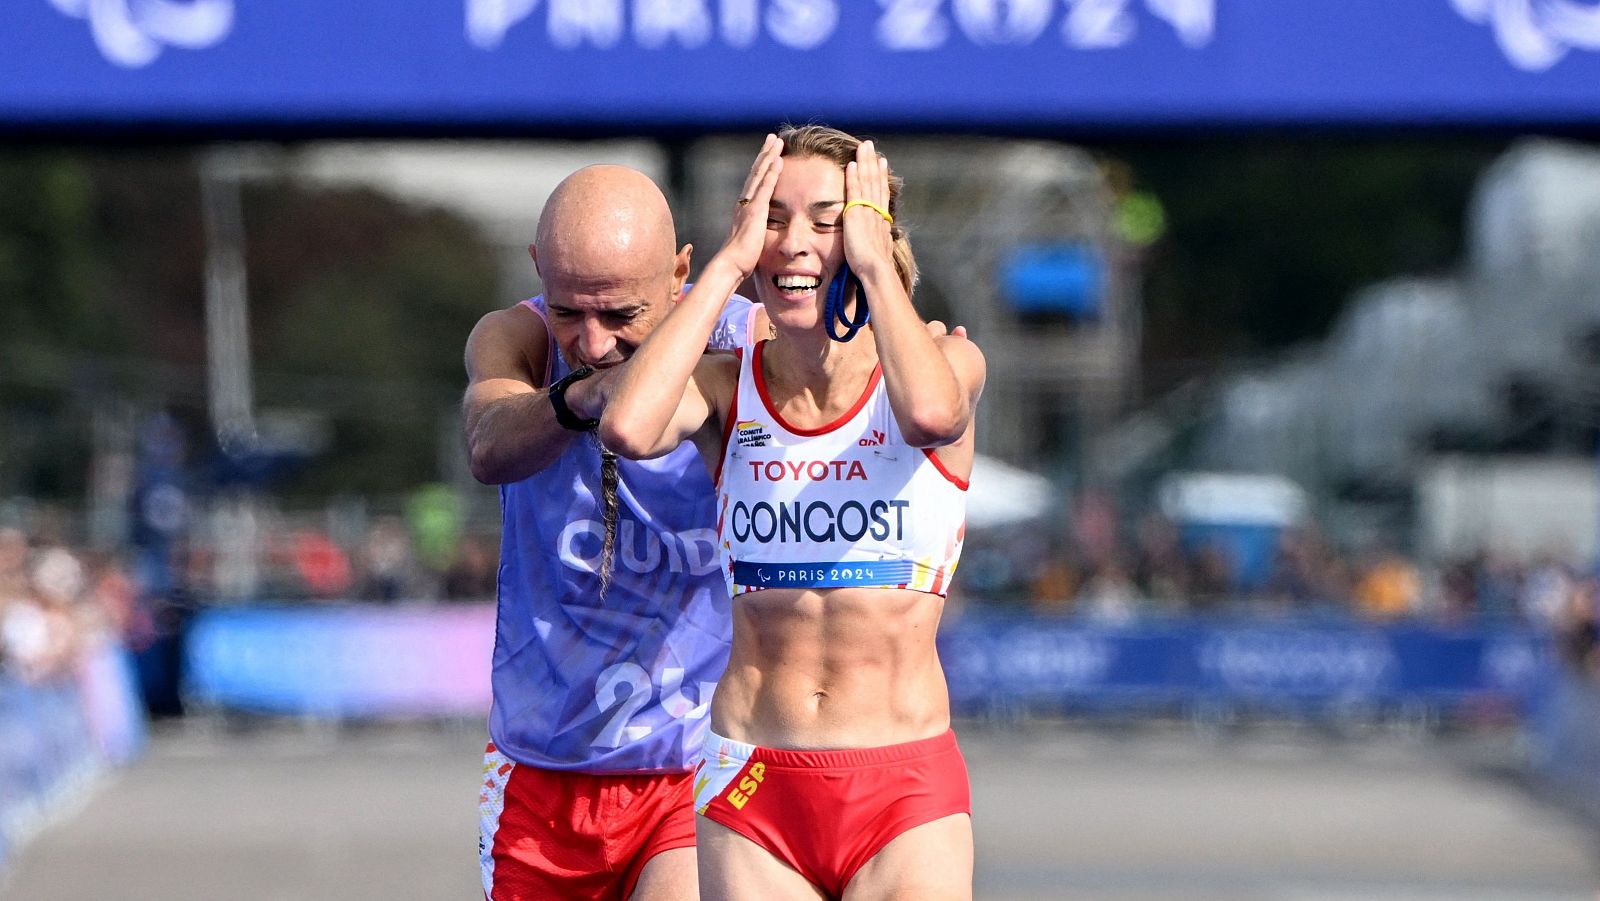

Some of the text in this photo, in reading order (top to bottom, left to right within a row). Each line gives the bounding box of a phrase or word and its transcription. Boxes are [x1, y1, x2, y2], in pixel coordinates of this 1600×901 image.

[748, 460, 868, 482] TOYOTA
[731, 499, 910, 544] CONGOST
[556, 519, 721, 577] GUID
[778, 568, 874, 581] PARIS 2024
[726, 761, 766, 811] ESP
